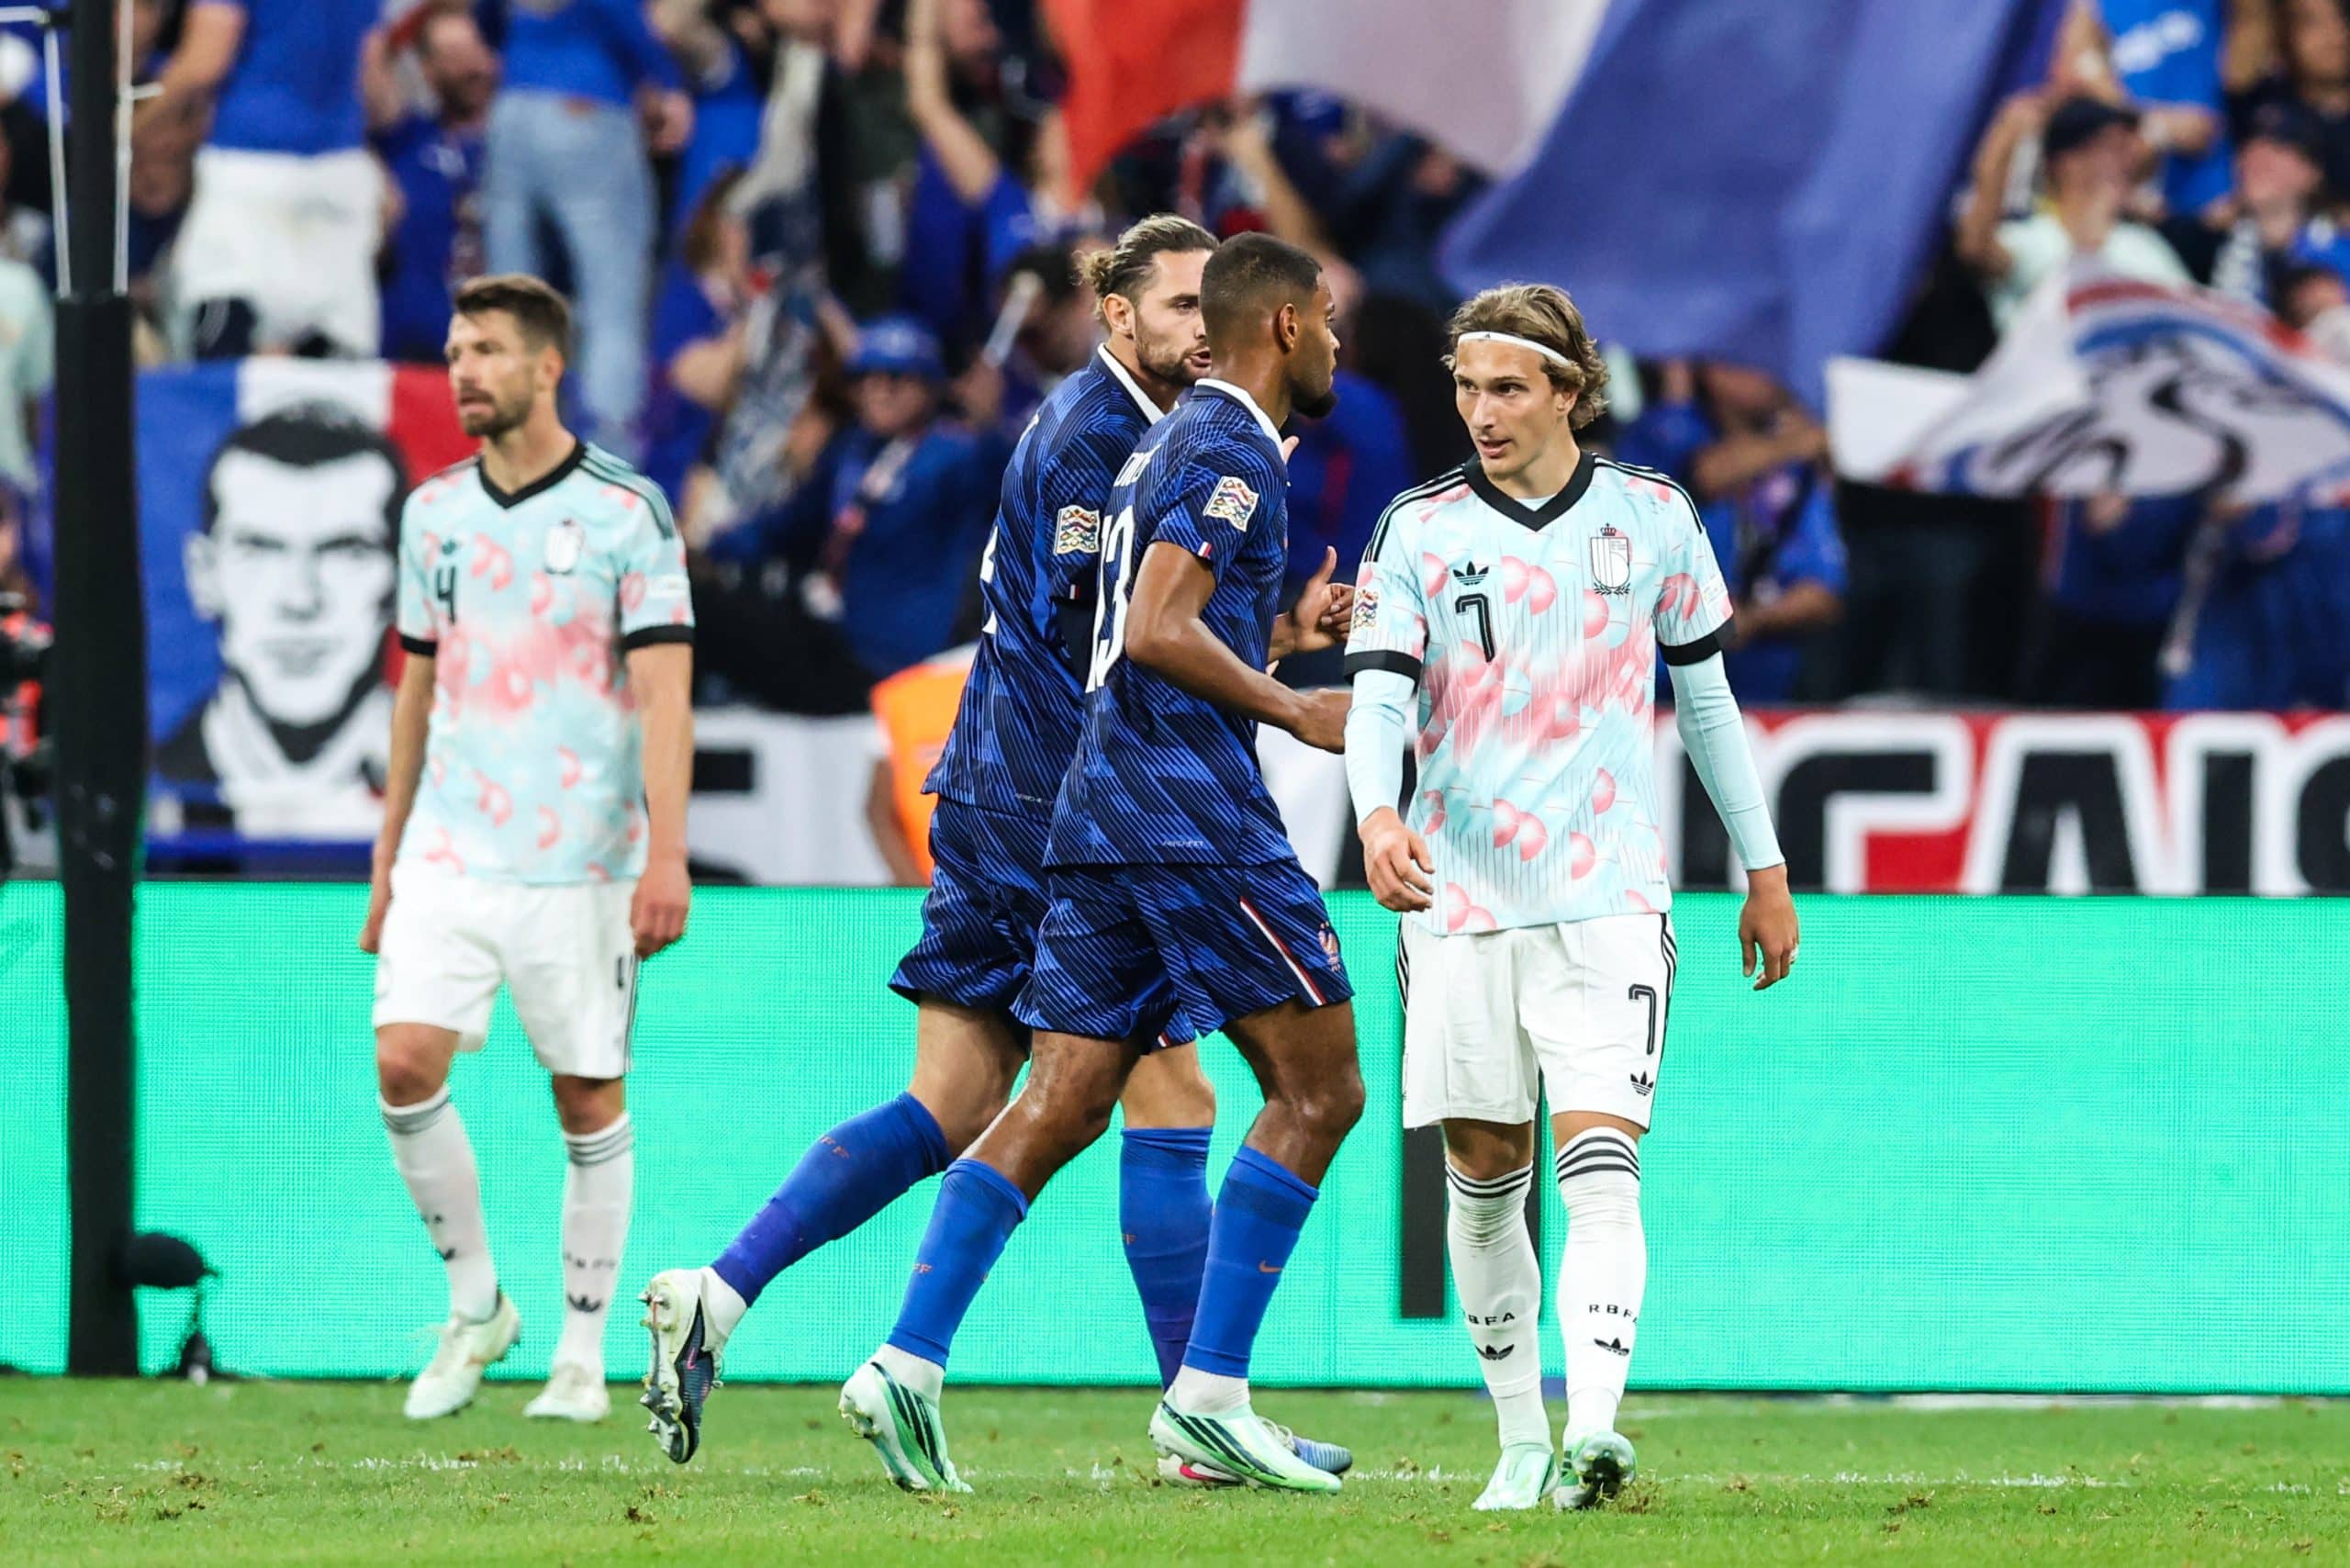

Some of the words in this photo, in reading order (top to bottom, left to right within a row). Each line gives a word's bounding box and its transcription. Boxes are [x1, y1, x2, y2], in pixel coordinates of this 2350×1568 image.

[436, 566, 457, 624] 4
[1454, 592, 1496, 663] 7
[1628, 983, 1657, 1056] 7
[1462, 1307, 1516, 1326] BFA
